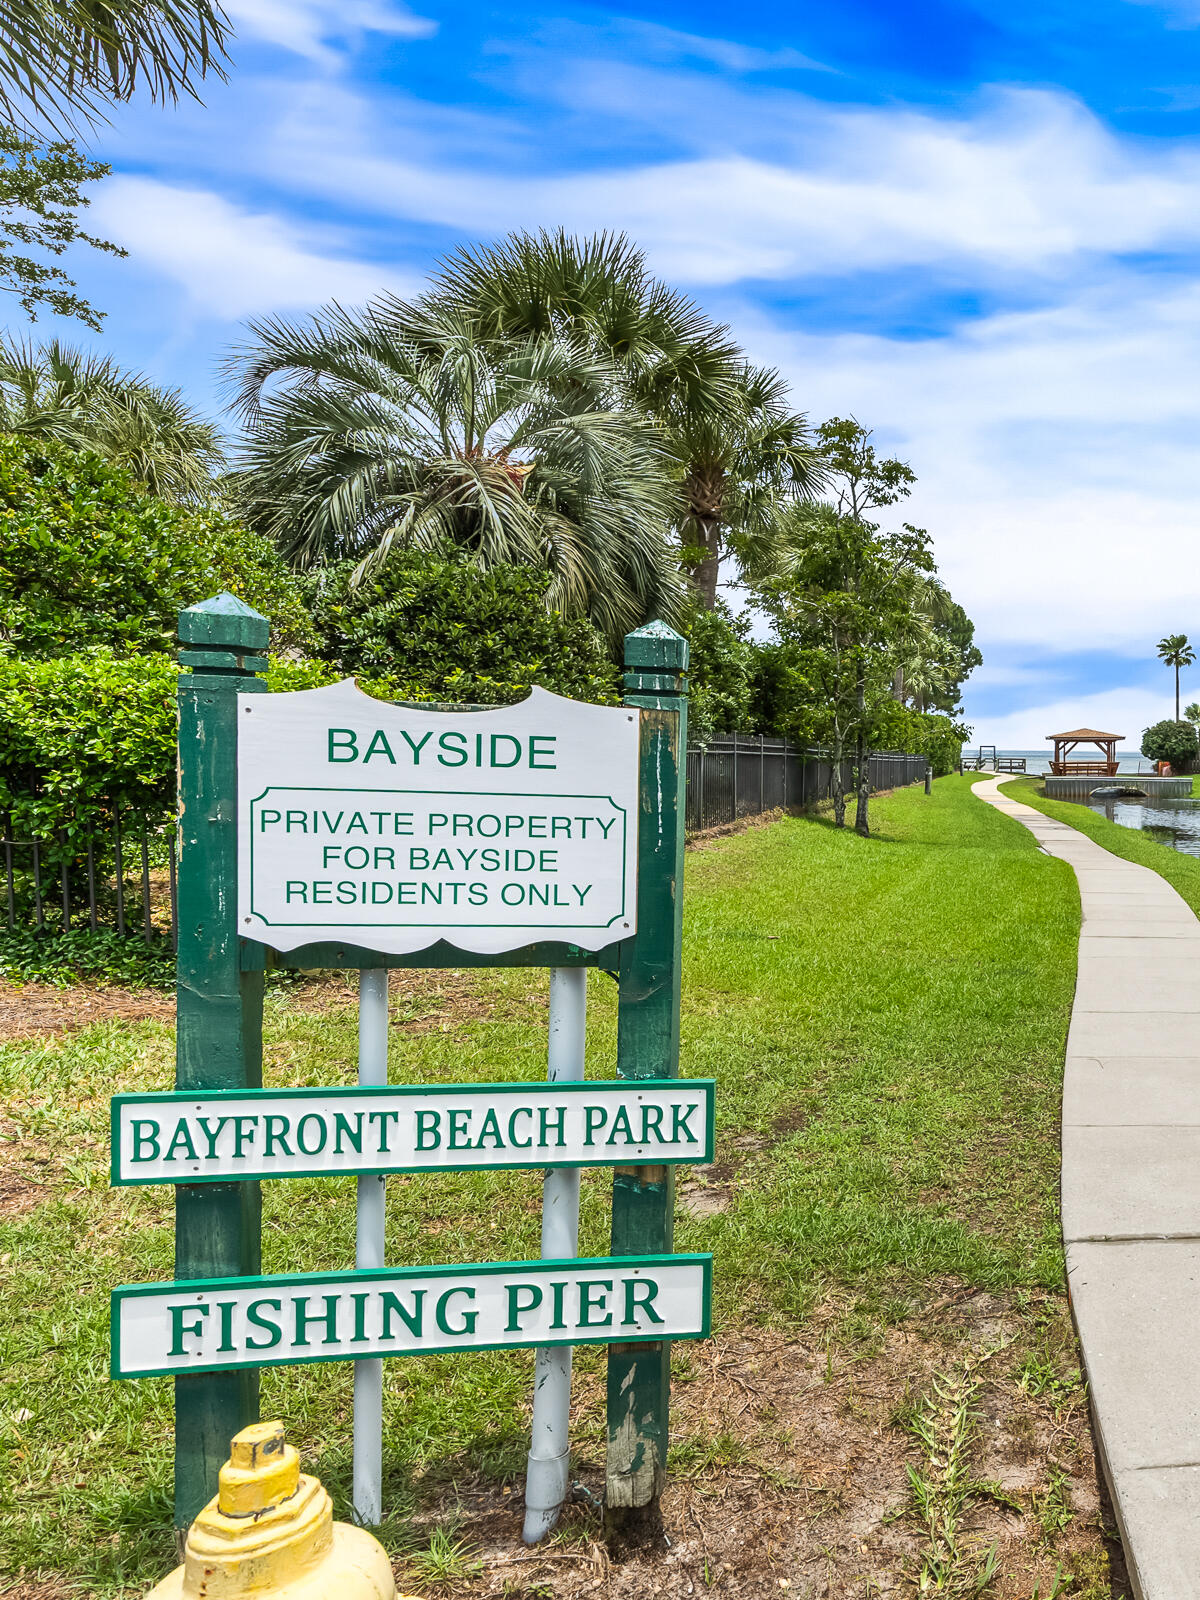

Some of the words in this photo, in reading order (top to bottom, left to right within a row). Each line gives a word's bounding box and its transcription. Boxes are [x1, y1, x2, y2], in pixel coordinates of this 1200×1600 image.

[328, 728, 557, 770] BAYSIDE
[260, 809, 414, 836] PRIVATE
[428, 813, 618, 840] PROPERTY
[323, 845, 396, 871] FOR
[410, 848, 558, 873] BAYSIDE
[286, 880, 488, 906] RESIDENTS
[500, 883, 593, 907] ONLY
[130, 1111, 399, 1163] BAYFRONT
[415, 1106, 568, 1151] BEACH
[583, 1104, 699, 1146] PARK
[166, 1286, 480, 1357] FISHING
[503, 1278, 666, 1332] PIER
